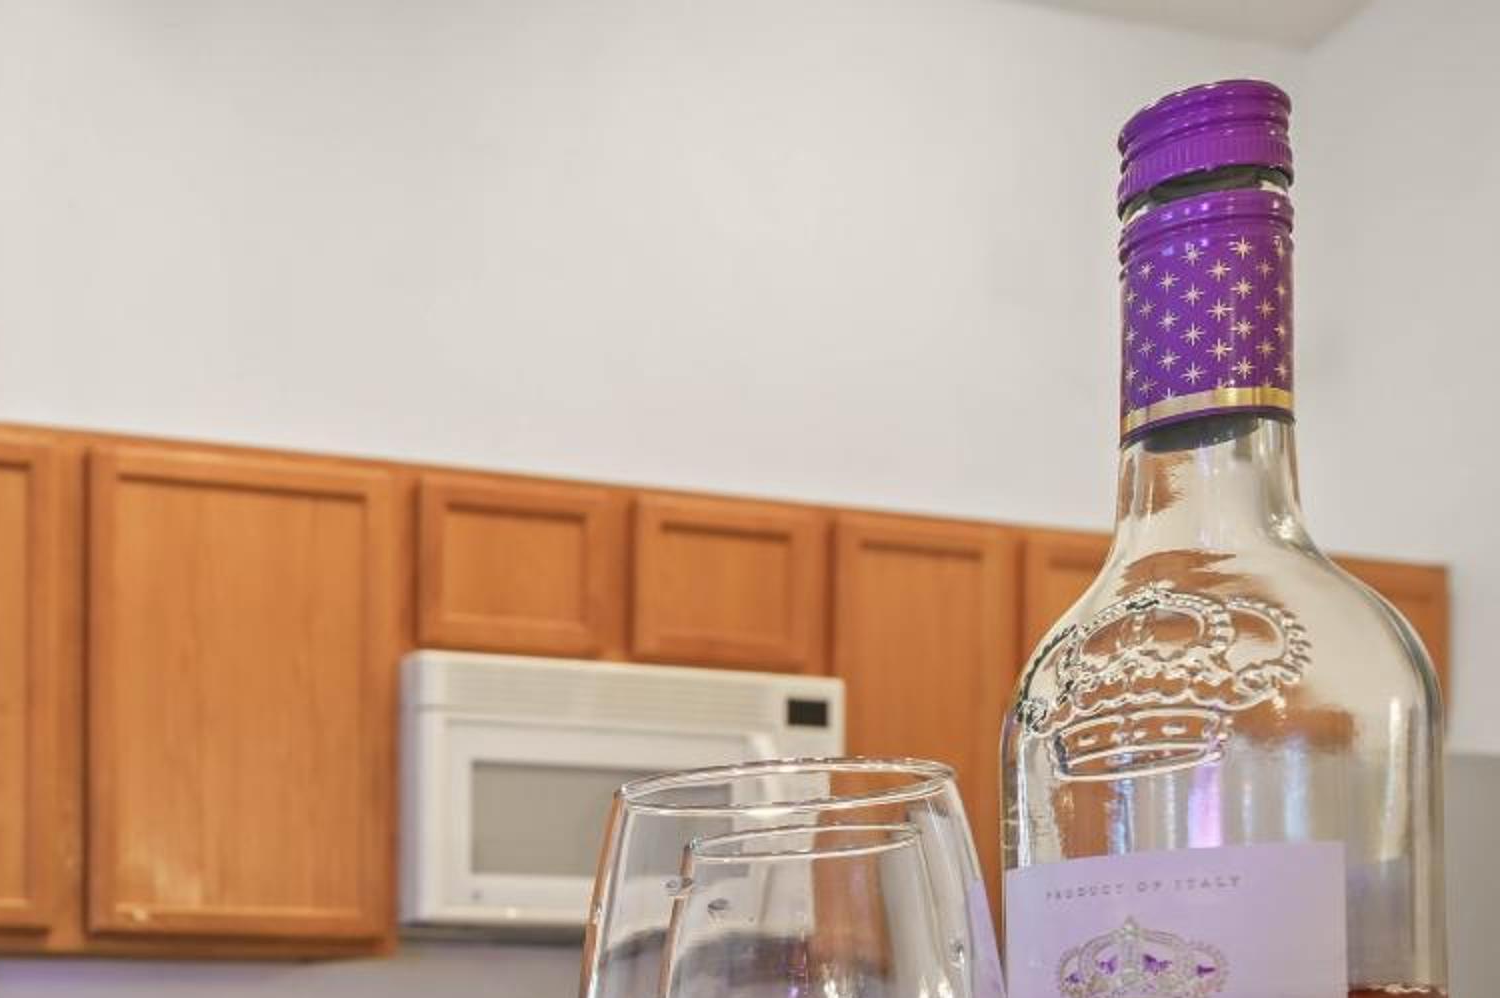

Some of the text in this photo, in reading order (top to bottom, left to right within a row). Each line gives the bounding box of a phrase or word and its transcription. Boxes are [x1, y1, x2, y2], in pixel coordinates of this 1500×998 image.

[1045, 875, 1242, 900] PRODUCT OF ITALY
